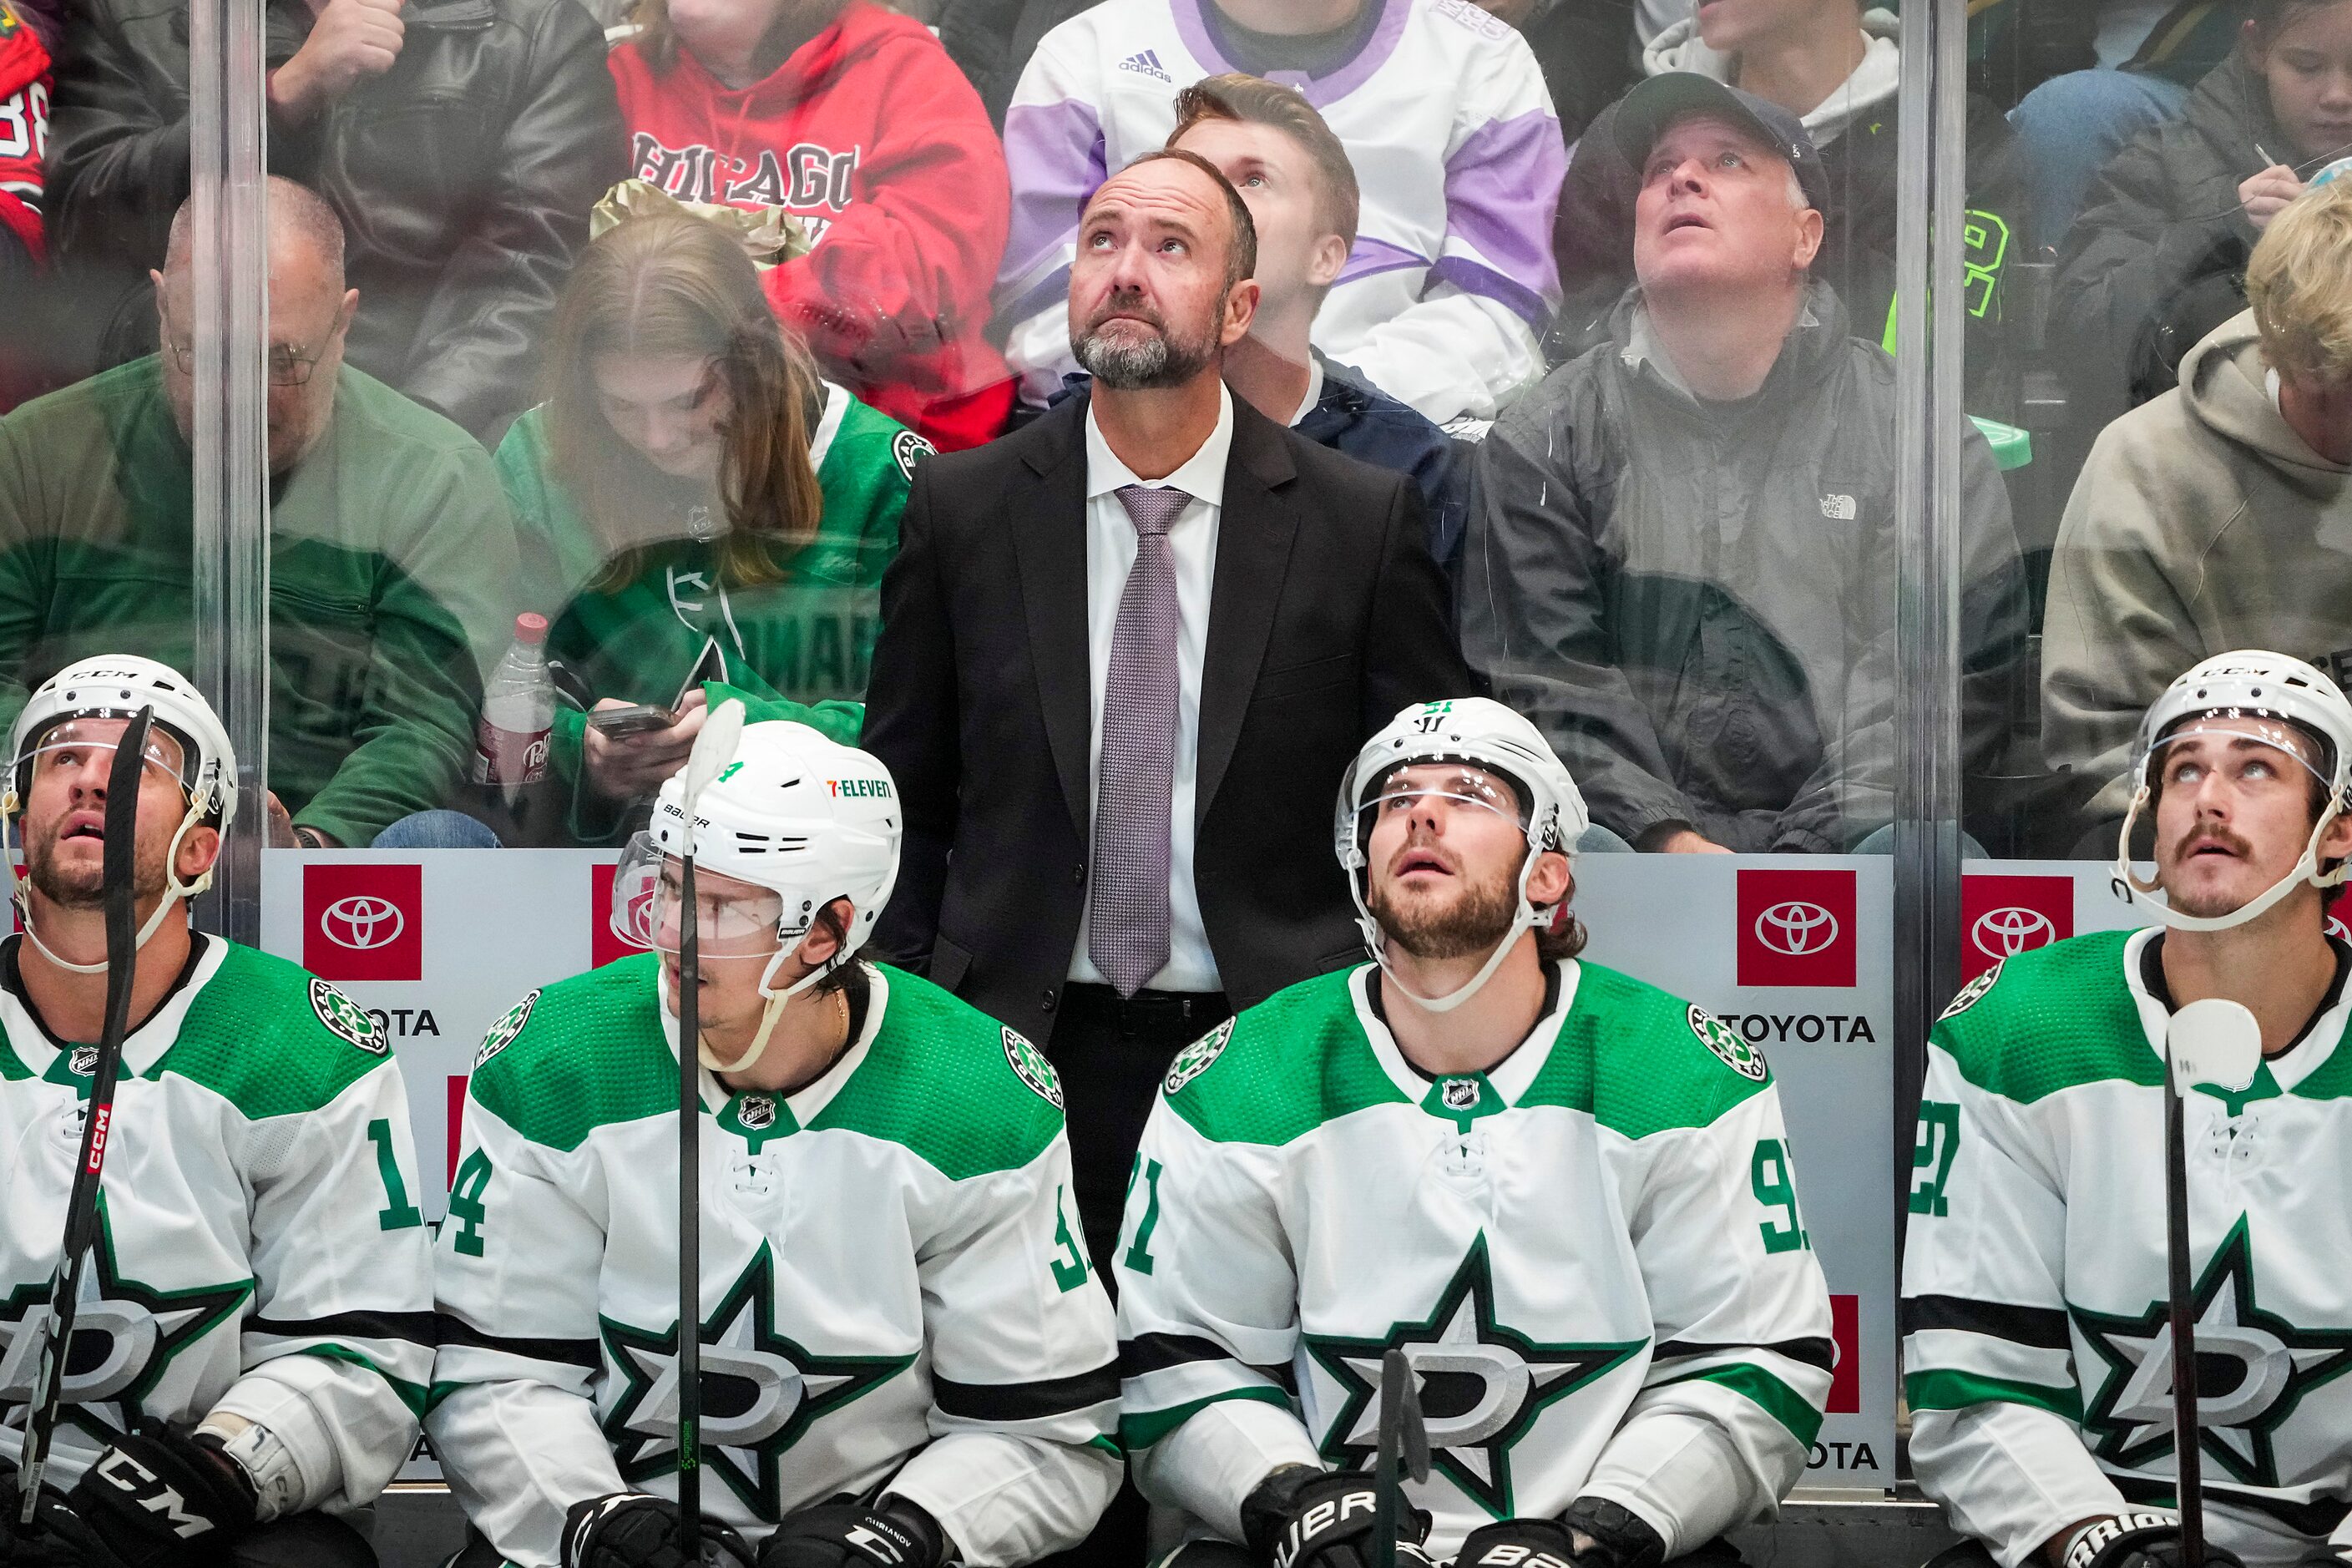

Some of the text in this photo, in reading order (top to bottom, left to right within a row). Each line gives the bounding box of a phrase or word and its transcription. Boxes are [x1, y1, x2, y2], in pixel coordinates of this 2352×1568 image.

[1119, 63, 1171, 83] adidas
[632, 132, 861, 213] HICAGO
[68, 670, 139, 681] CCM
[717, 761, 745, 784] 4
[1717, 1014, 1876, 1043] TOYOTA
[89, 1109, 109, 1170] CCM
[96, 1444, 215, 1540] CM
